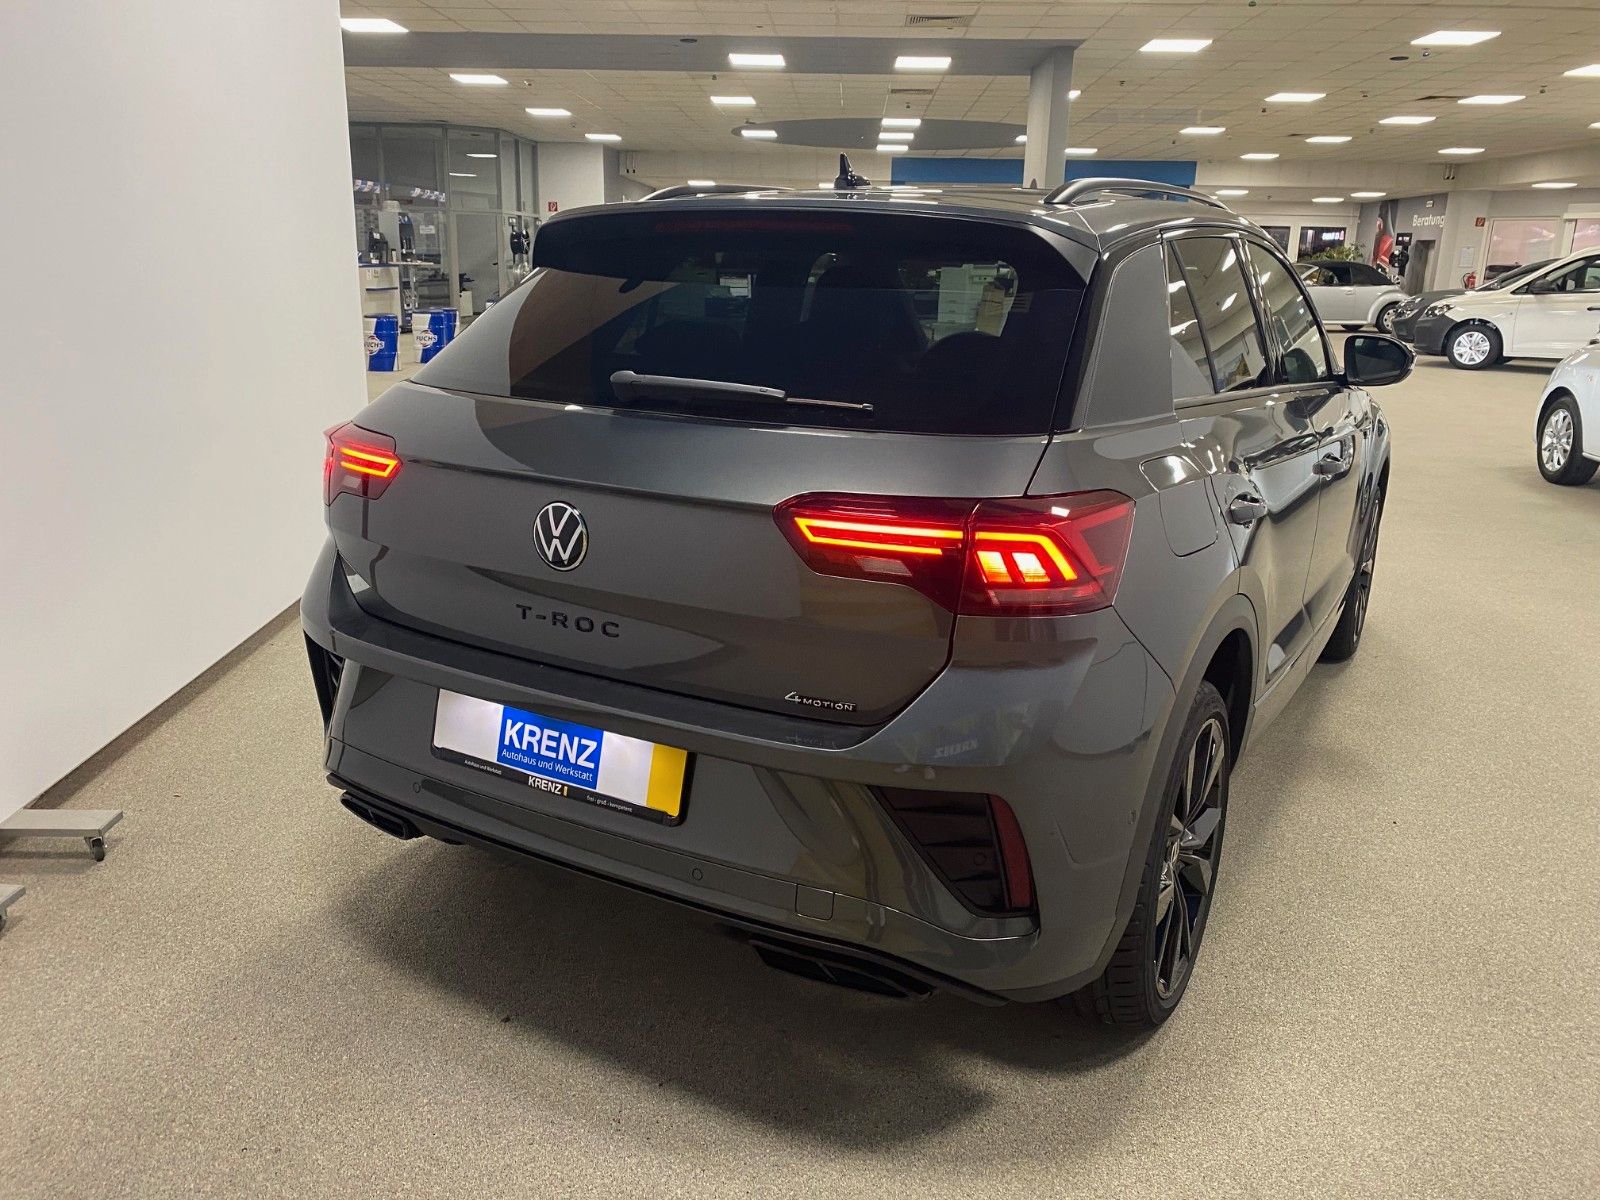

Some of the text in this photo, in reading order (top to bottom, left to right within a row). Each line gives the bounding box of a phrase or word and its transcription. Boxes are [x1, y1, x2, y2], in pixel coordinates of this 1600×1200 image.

[1412, 214, 1445, 228] Beratung
[416, 334, 437, 343] FUCHS
[535, 503, 586, 566] VW
[515, 603, 619, 638] T-ROC
[784, 691, 856, 711] 4MOTION
[503, 718, 598, 769] KRENZ
[501, 748, 593, 782] Autohaus und Werkstatt
[528, 775, 562, 795] KRENZ
